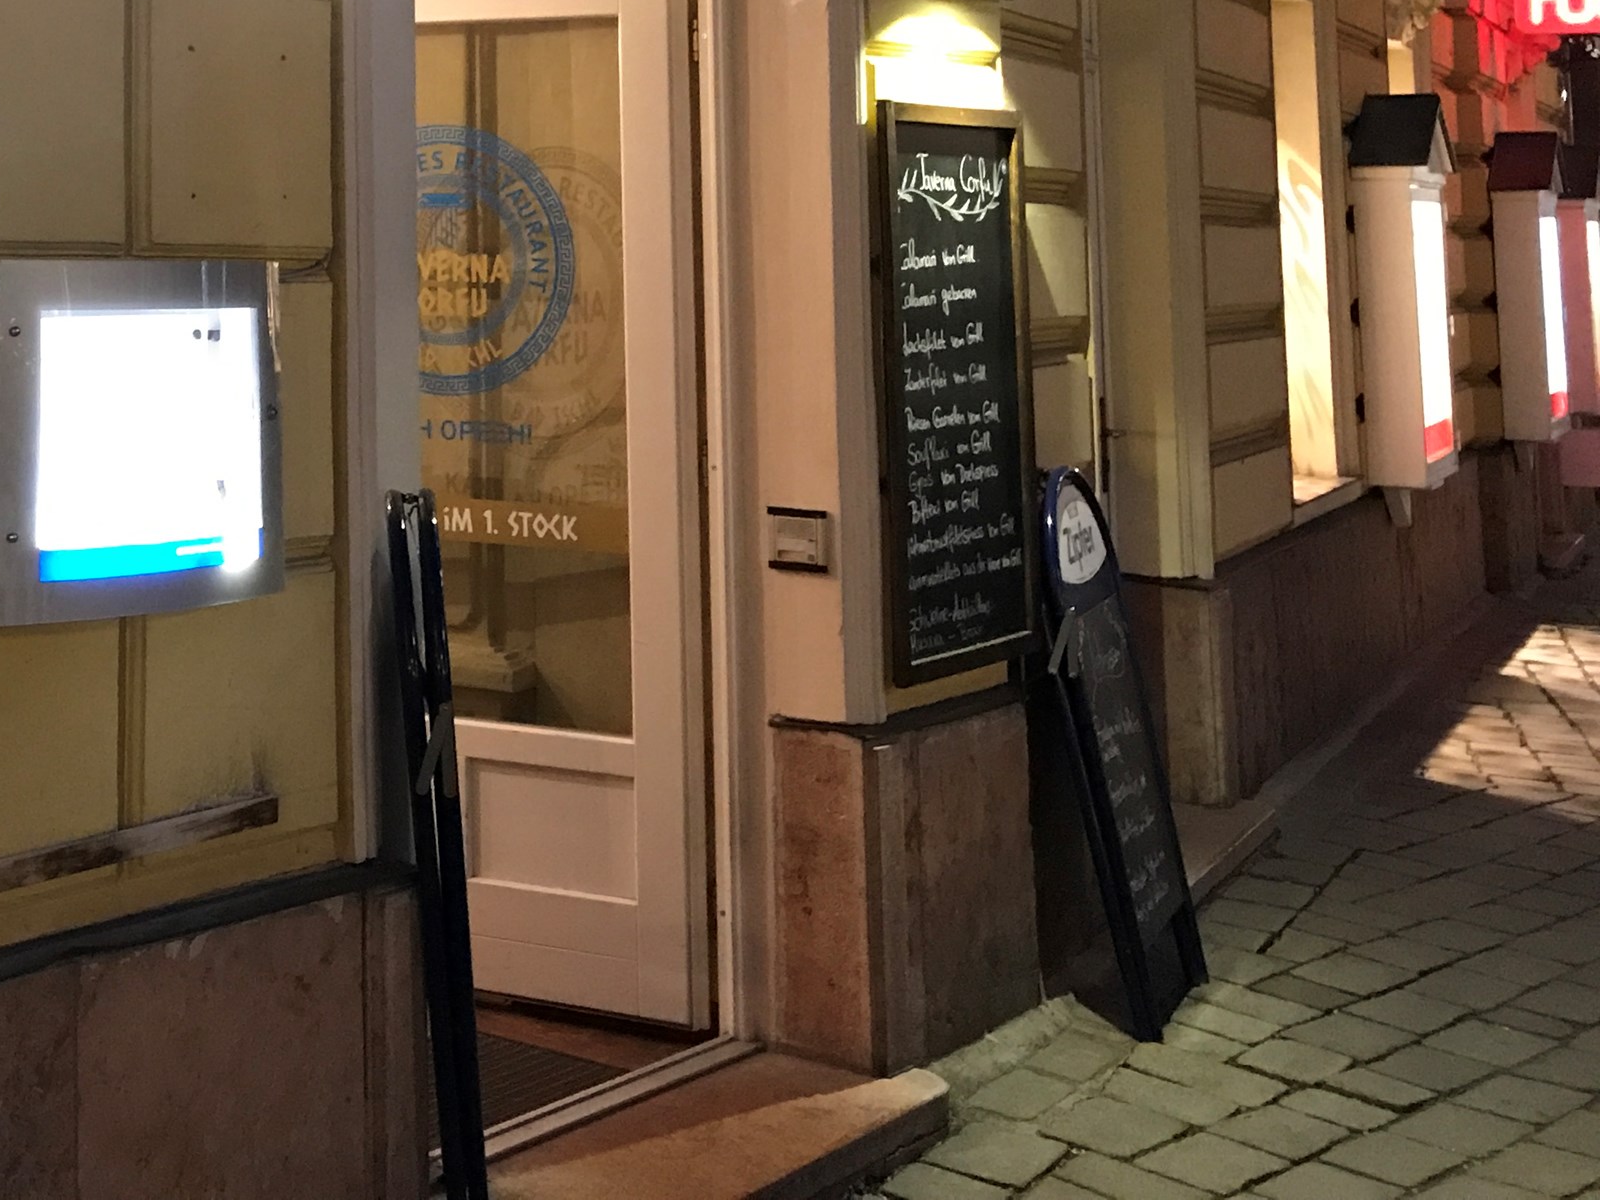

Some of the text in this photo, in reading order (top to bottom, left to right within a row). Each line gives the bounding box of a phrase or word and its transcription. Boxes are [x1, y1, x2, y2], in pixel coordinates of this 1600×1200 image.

[916, 153, 994, 203] Taverna Corfu
[417, 252, 510, 285] VERNA
[417, 287, 488, 318] ORFU
[483, 509, 498, 535] 1.
[507, 510, 578, 541] STOCK
